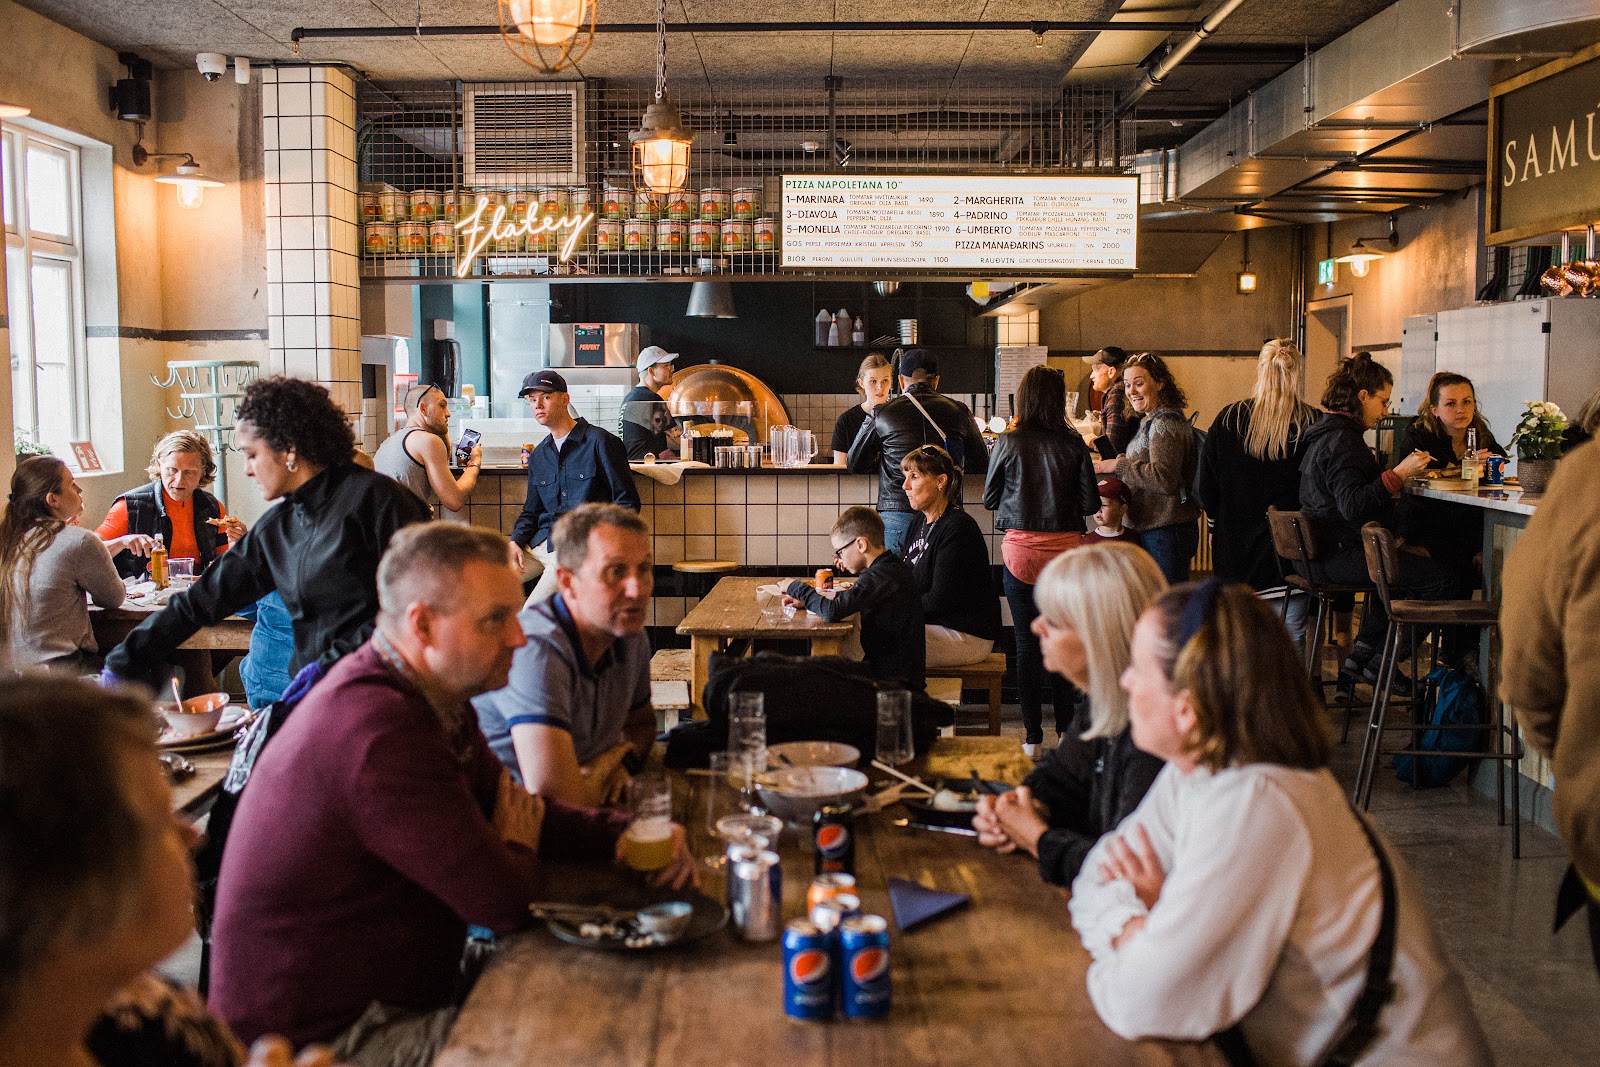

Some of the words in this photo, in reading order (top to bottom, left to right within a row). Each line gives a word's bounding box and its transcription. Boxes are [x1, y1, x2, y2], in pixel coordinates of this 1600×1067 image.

[786, 180, 814, 189] PIZZA
[818, 180, 882, 189] NAPOLETANA
[956, 241, 980, 249] PIZZA
